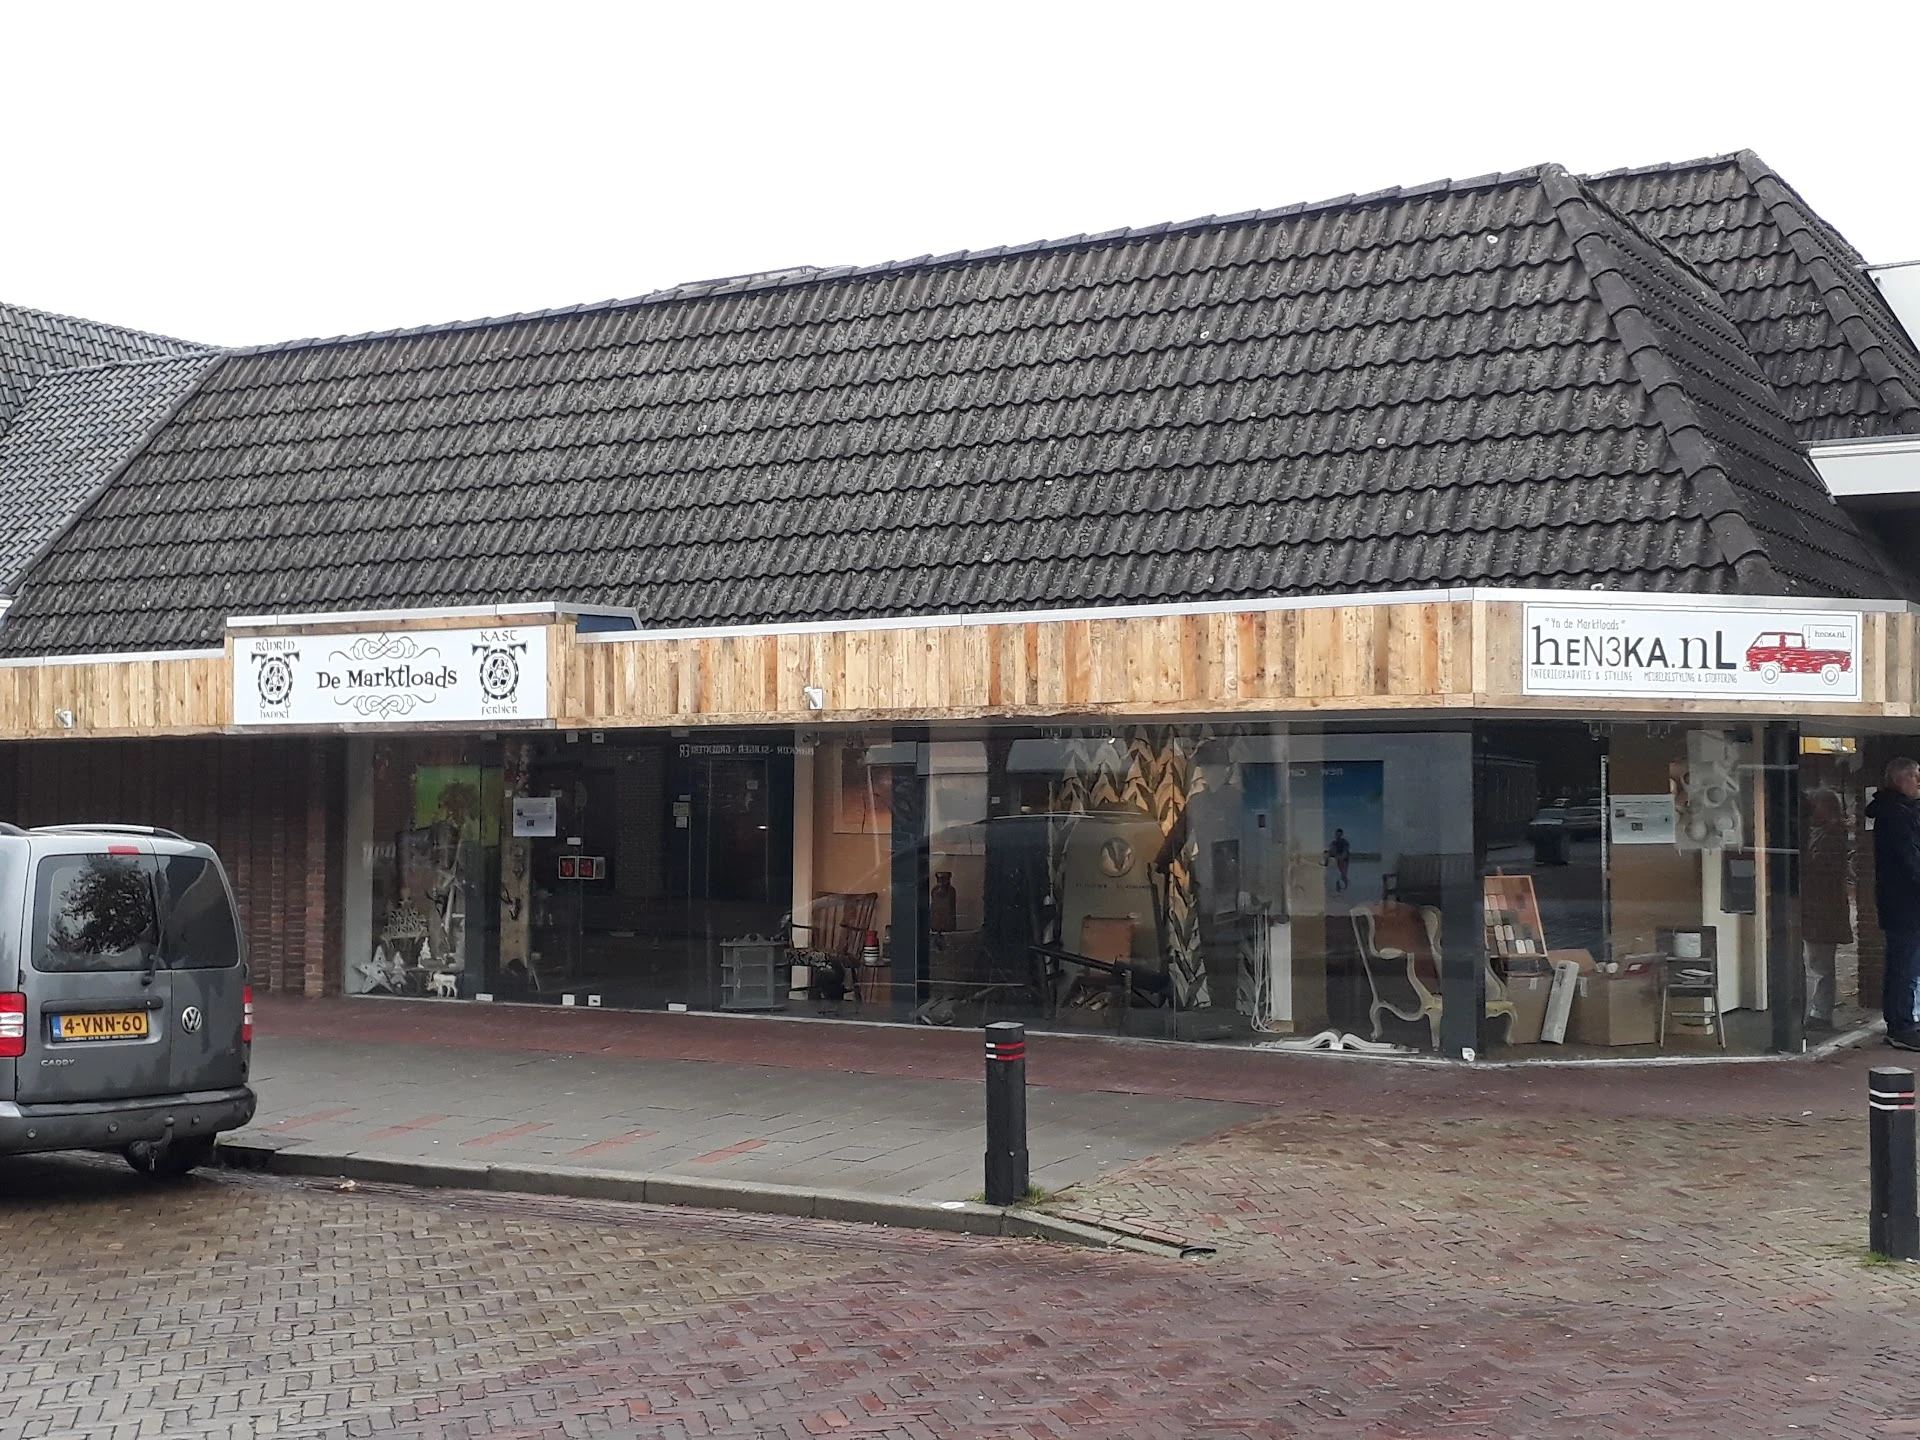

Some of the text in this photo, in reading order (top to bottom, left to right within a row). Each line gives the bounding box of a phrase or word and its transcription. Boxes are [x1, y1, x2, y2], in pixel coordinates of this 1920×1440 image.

[1563, 618, 1574, 629] de
[480, 630, 518, 642] KAST
[315, 663, 458, 689] De Marktloads
[1604, 670, 1633, 682] STYLING
[64, 1015, 143, 1034] 4-VNN-60
